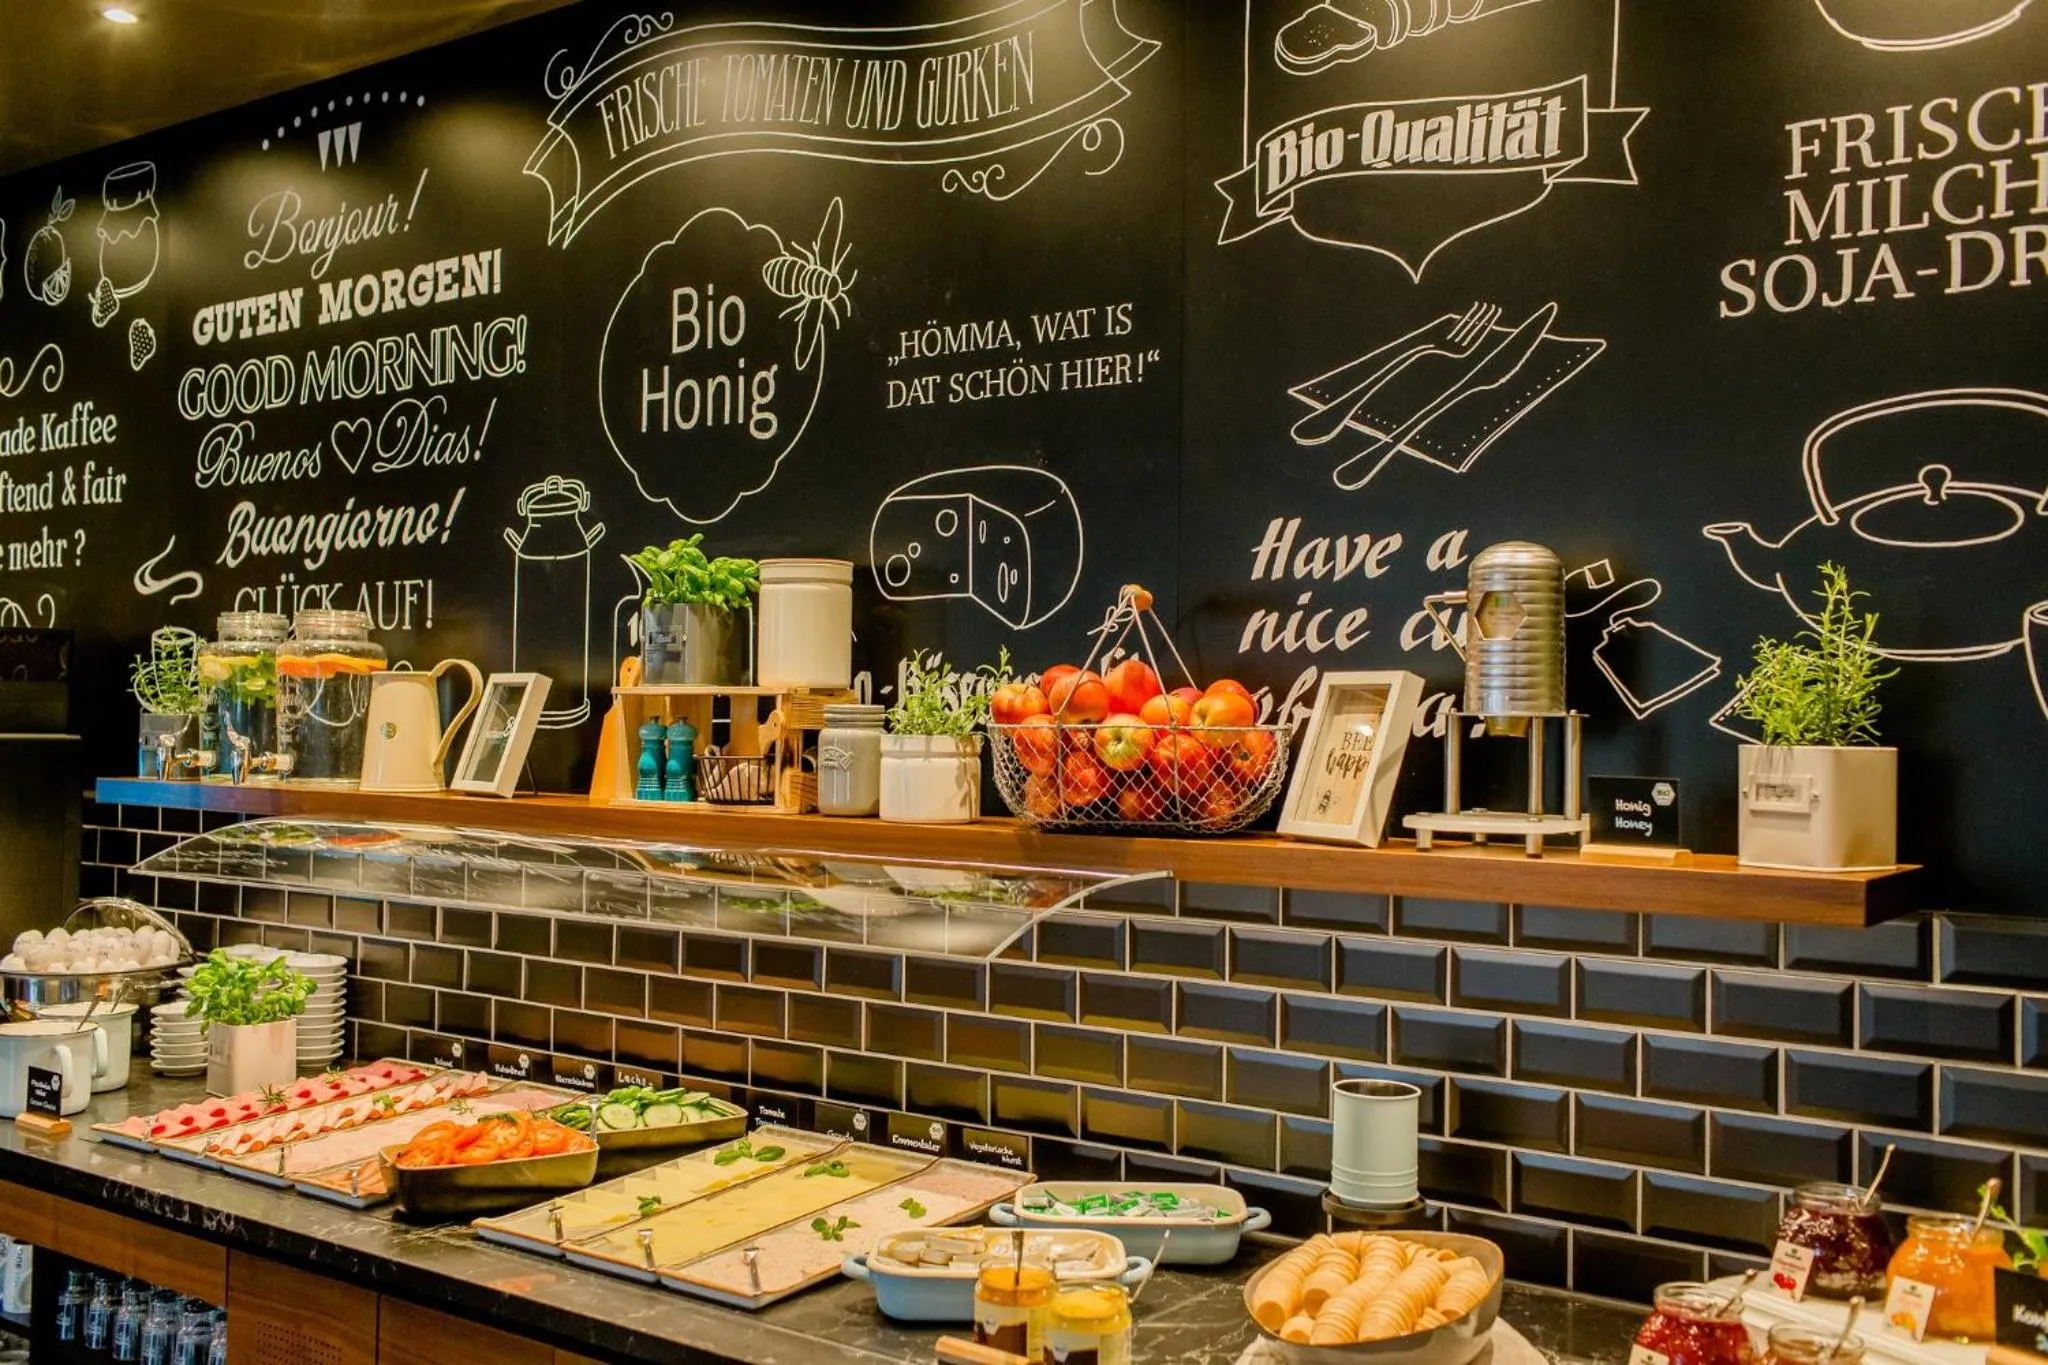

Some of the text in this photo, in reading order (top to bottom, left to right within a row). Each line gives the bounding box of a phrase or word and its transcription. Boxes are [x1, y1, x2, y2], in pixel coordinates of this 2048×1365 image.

[596, 31, 1036, 160] FRISCHE TOMATEN UND GURKEN
[1265, 95, 1567, 196] Bio-Qualität
[244, 168, 429, 280] Bonjour!
[192, 248, 502, 346] GUTEN MORGEN!
[672, 282, 746, 354] Bio
[1031, 307, 1096, 344] WAT
[1105, 303, 1133, 336] IS
[178, 314, 527, 420] GOOD MORNING!
[641, 357, 778, 440] Honig
[886, 375, 940, 409] DAT
[949, 356, 1063, 404] SCHÖN
[40, 401, 118, 451] Kaffee
[195, 395, 498, 489] Buenos Dias!
[61, 465, 76, 506] &
[82, 460, 126, 505] fair
[216, 486, 466, 571] Buongiorno!
[1251, 517, 1469, 582] Have a
[354, 579, 434, 631] AUF!
[1238, 591, 1371, 653] nice
[1615, 798, 1652, 817] Honig
[1615, 816, 1653, 837] Honey
